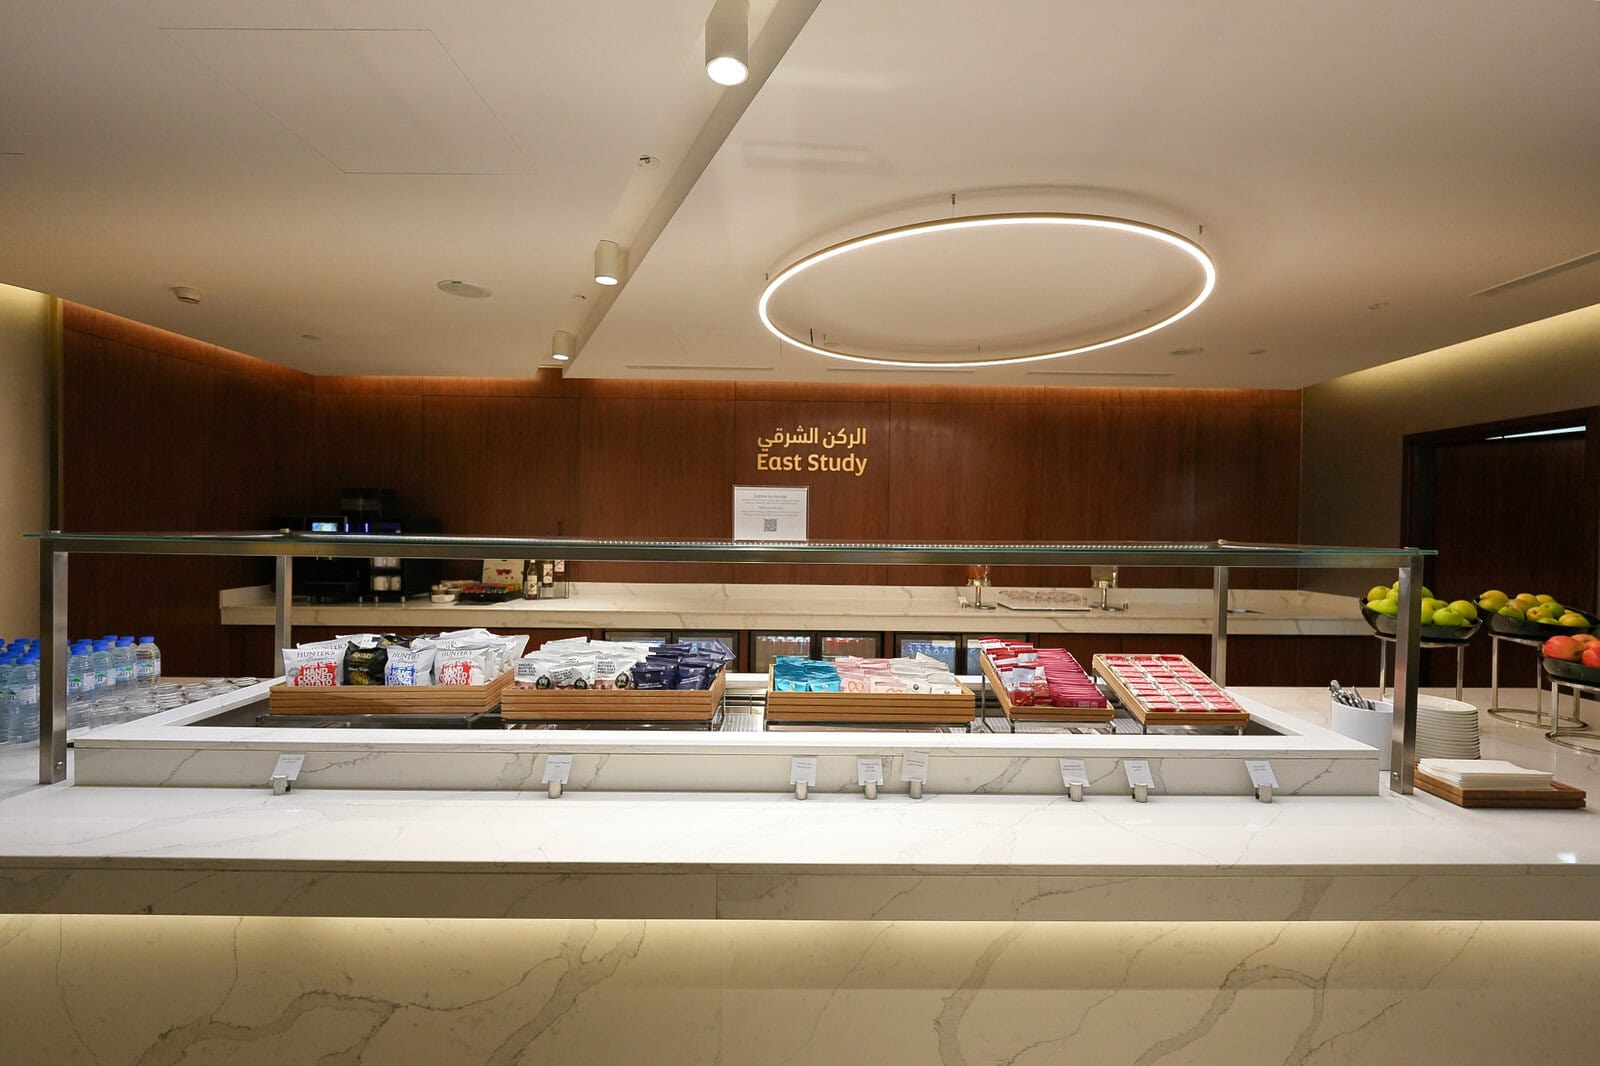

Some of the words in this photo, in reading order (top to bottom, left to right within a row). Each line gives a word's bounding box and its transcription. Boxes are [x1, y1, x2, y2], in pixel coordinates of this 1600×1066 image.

[757, 425, 819, 452] الشرقي
[822, 427, 867, 448] الركن
[757, 453, 802, 471] East
[807, 453, 868, 476] Study
[298, 673, 333, 682] COOKED
[303, 667, 328, 676] HAND
[443, 666, 463, 674] HAND
